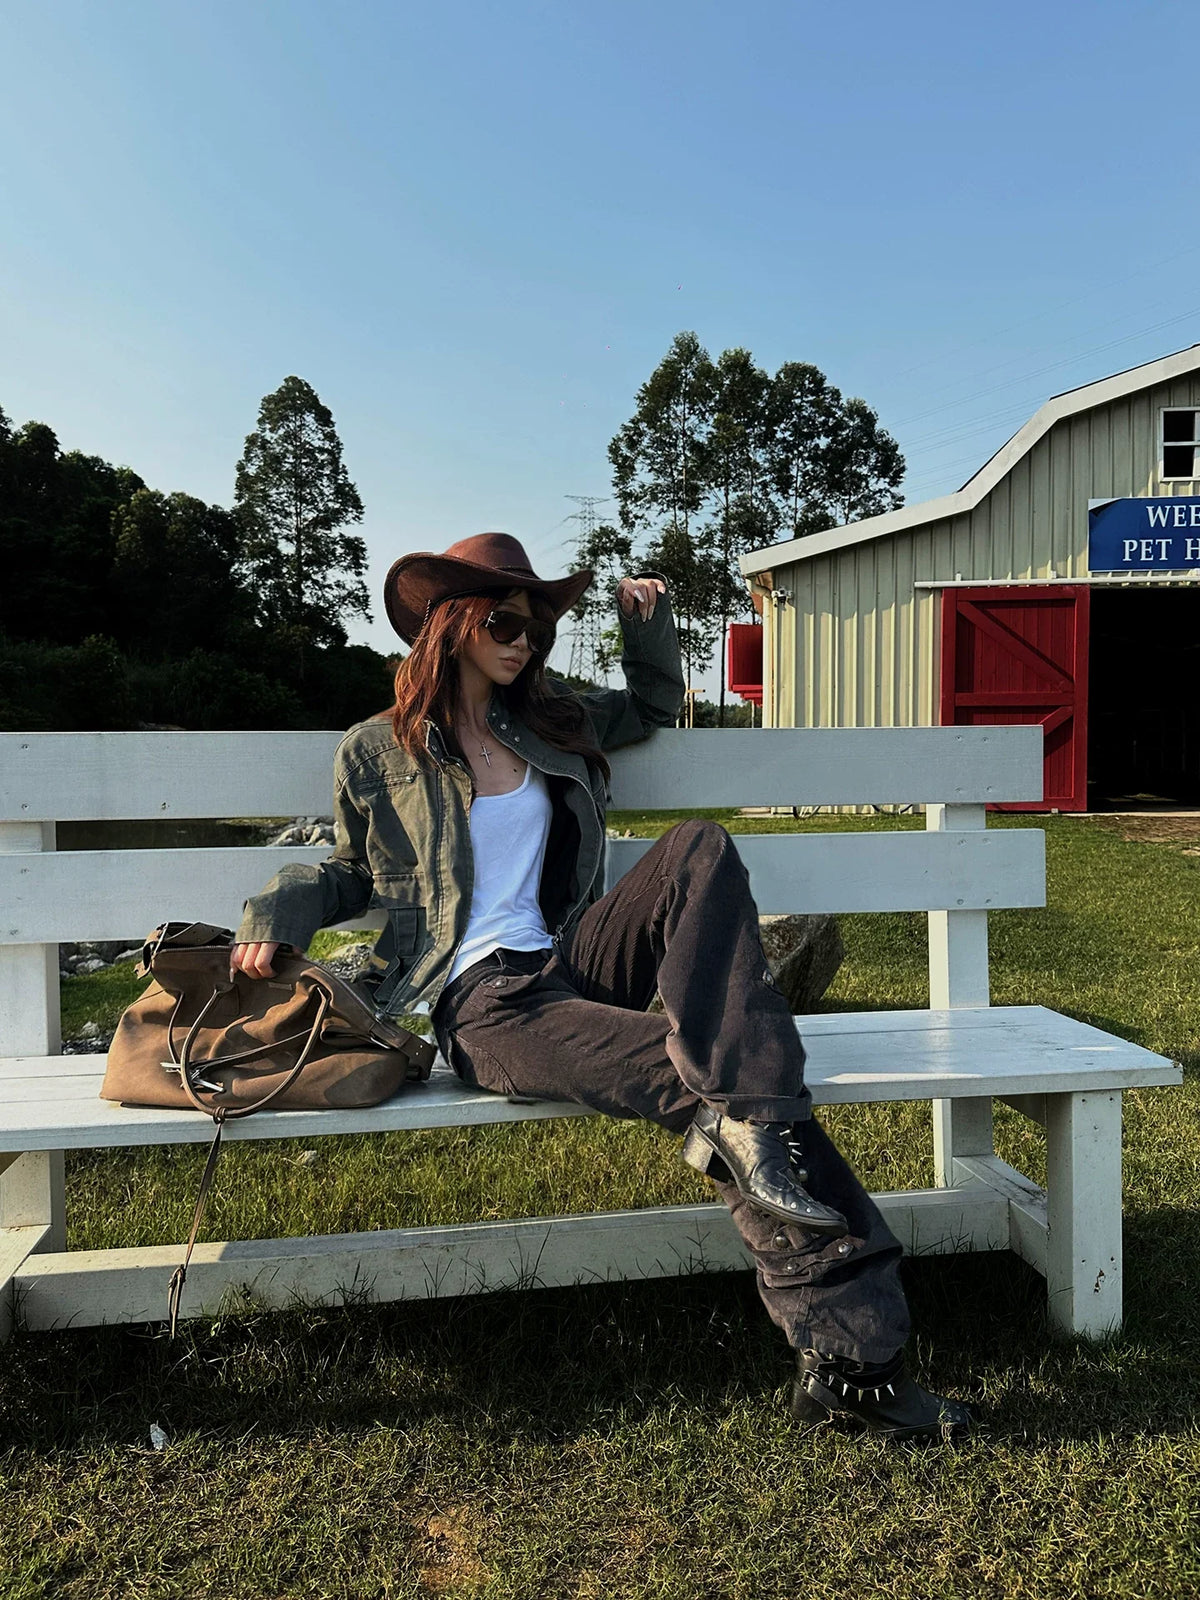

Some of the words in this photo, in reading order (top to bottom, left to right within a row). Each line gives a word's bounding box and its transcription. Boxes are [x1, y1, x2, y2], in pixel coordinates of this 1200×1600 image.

[1146, 505, 1200, 528] WEE
[1122, 539, 1173, 561] PET
[1184, 538, 1200, 560] H
